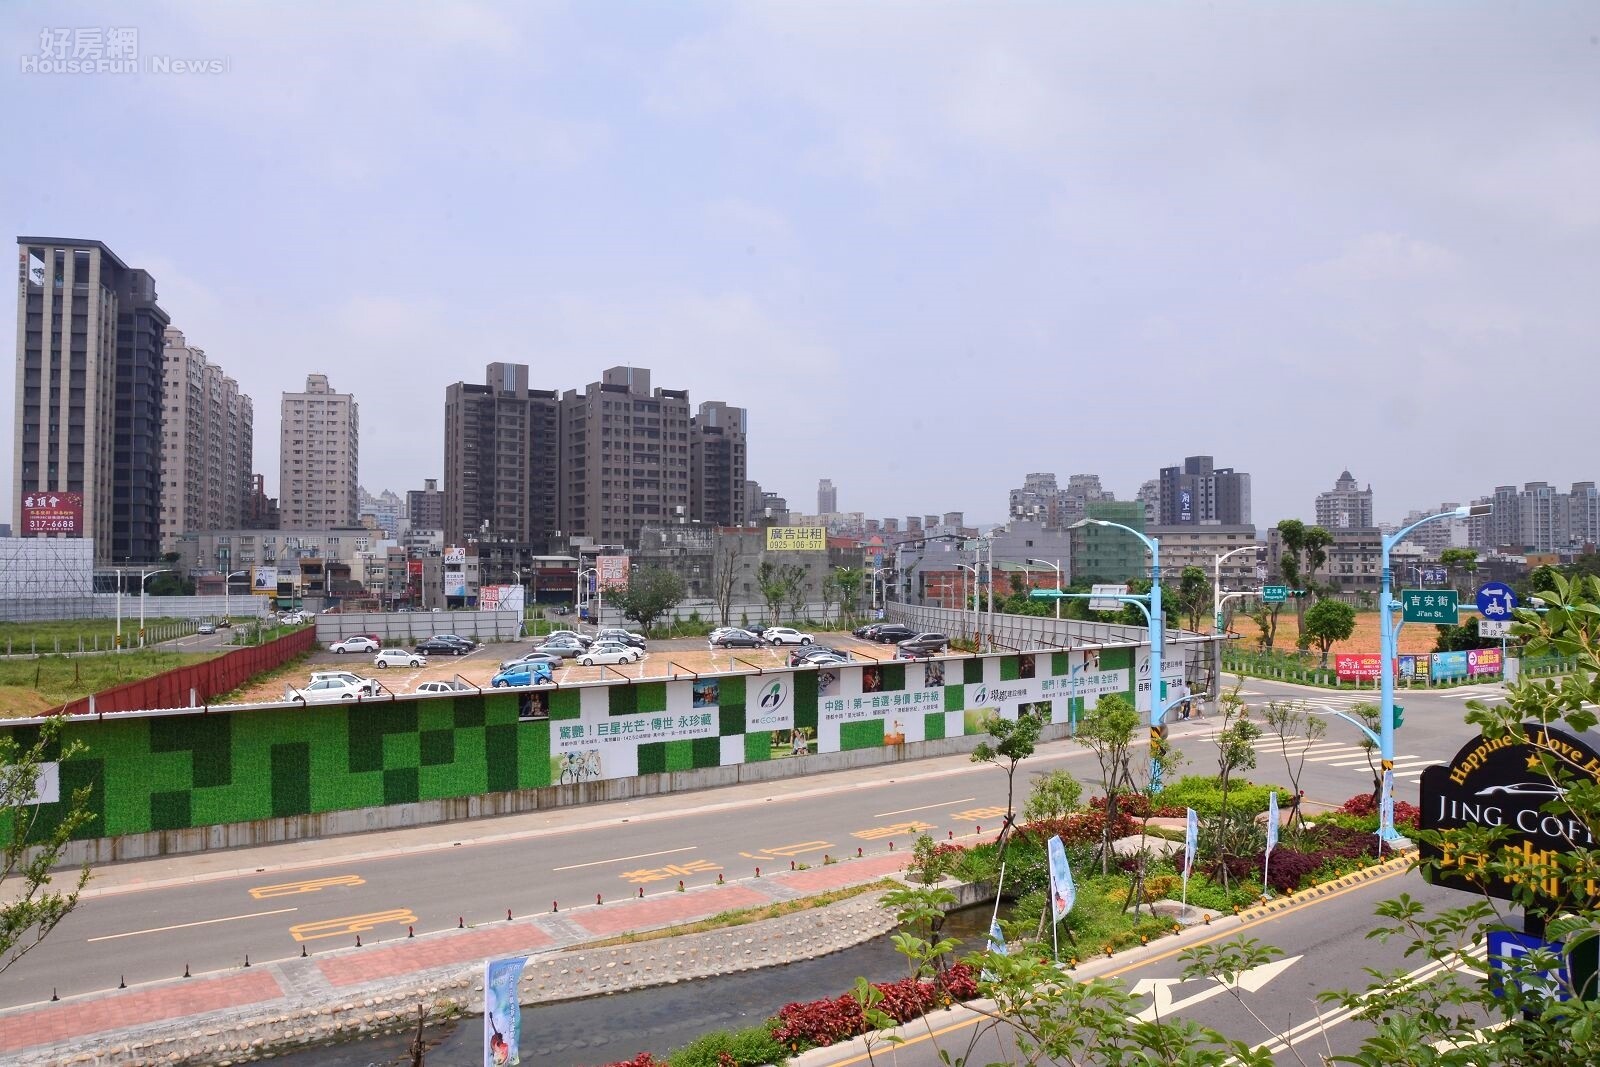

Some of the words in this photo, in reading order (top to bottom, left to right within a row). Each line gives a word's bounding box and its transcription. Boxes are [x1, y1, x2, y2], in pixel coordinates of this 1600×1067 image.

[771, 528, 822, 539] 廣告出租
[1411, 595, 1448, 606] 吉安街
[913, 690, 940, 704] 更升級
[678, 712, 712, 728] 永珍藏
[1450, 732, 1530, 786] Happines
[1537, 730, 1584, 762] Love
[1438, 795, 1503, 827] JING
